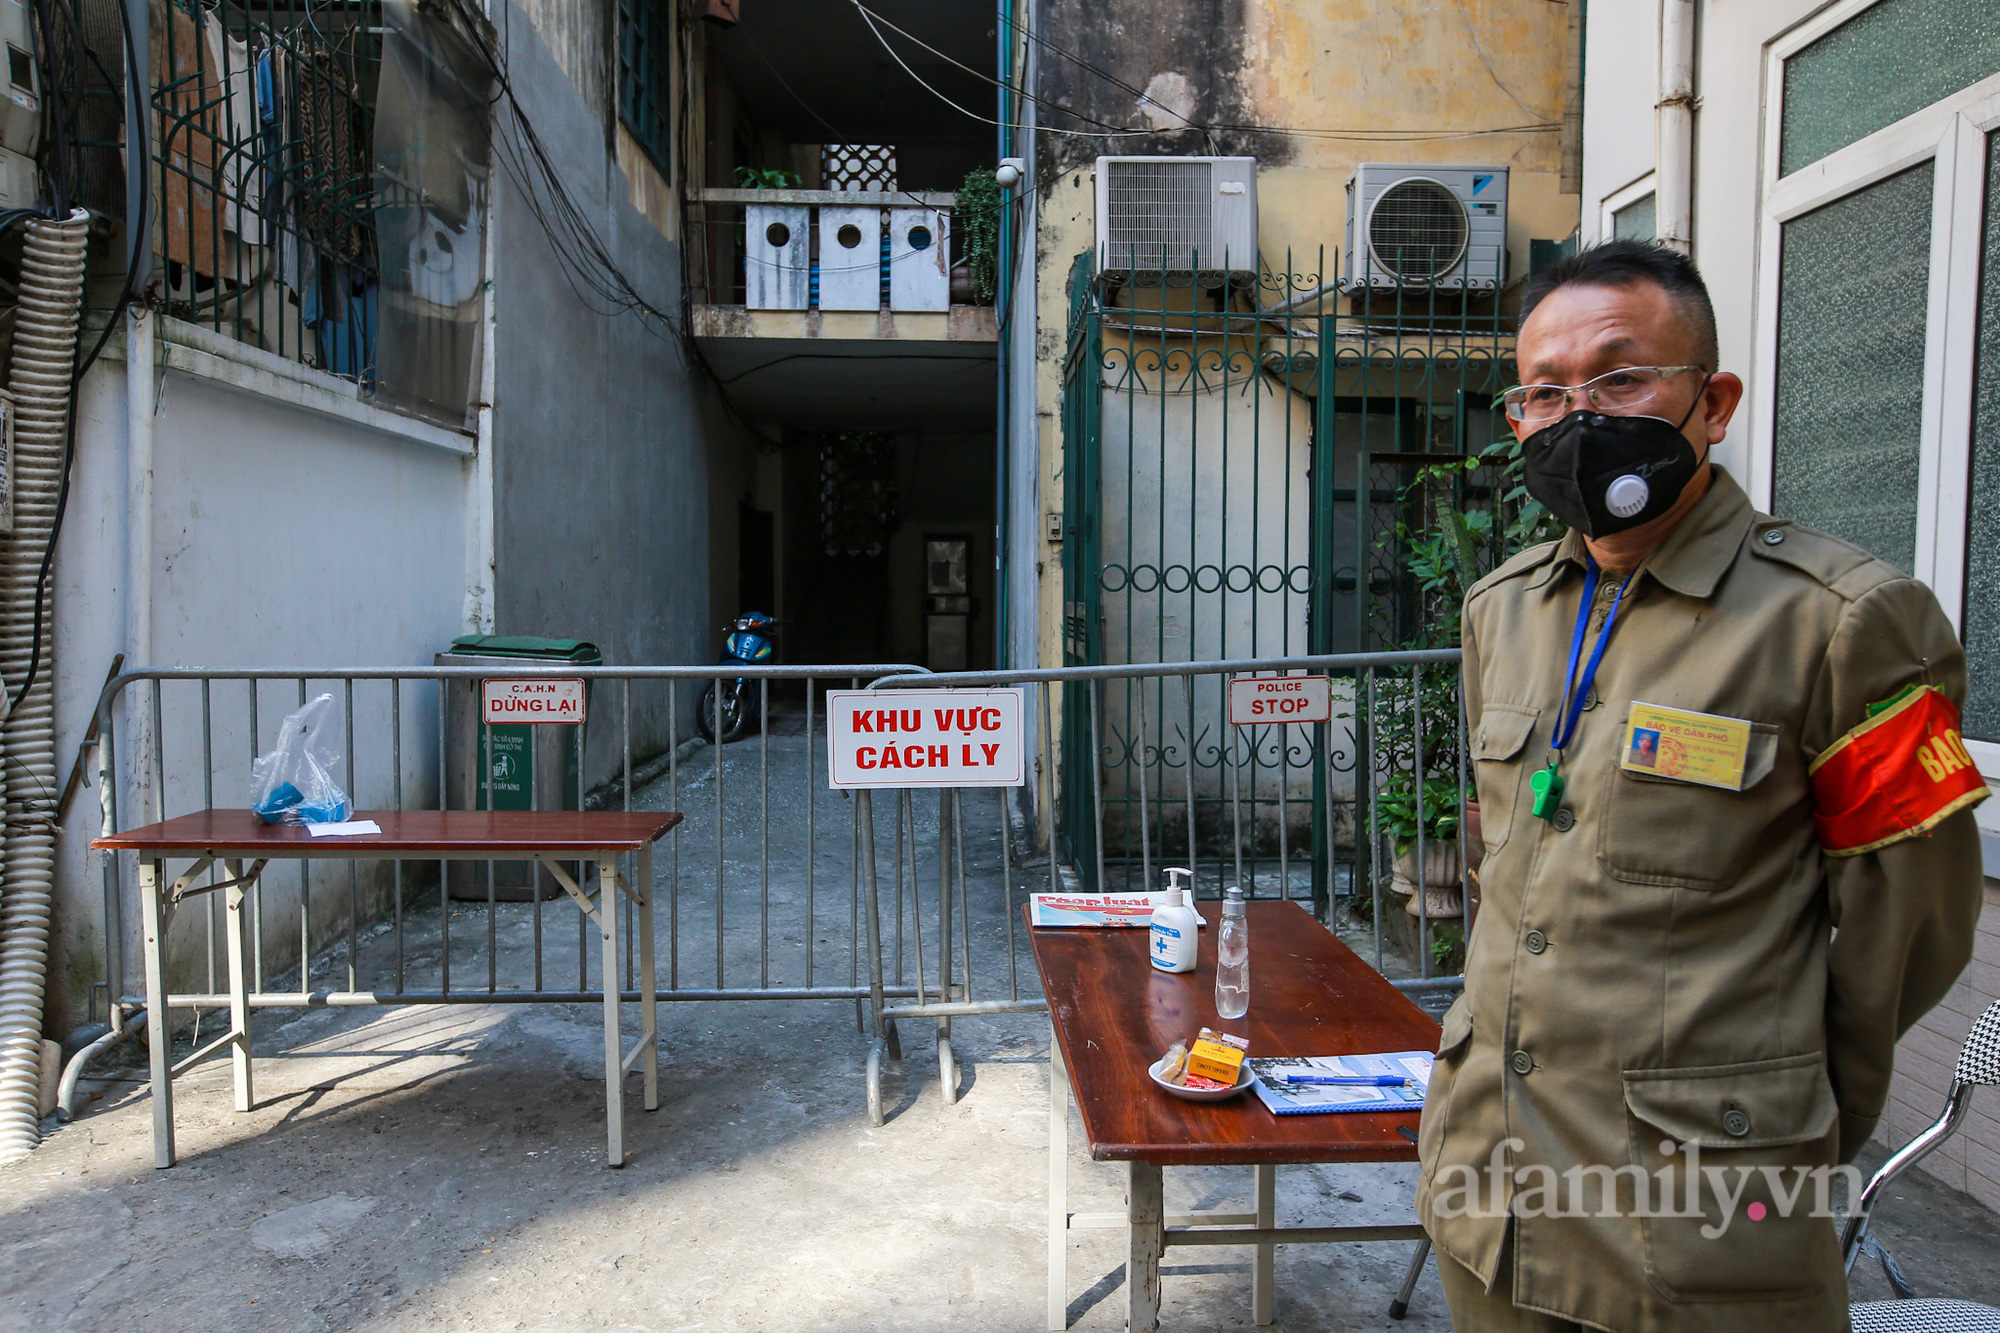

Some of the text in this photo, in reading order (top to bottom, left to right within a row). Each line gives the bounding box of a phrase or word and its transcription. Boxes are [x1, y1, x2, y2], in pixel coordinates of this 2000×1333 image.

[511, 684, 556, 693] C.A.H.N
[1257, 682, 1302, 693] POLICE
[491, 694, 577, 715] DỪNG LẠI
[1251, 698, 1309, 714] STOP
[852, 706, 1002, 736] KHU VỰC
[1669, 725, 1682, 736] VỆ
[1683, 727, 1705, 739] DÂN
[856, 740, 1001, 769] CÁCH LY
